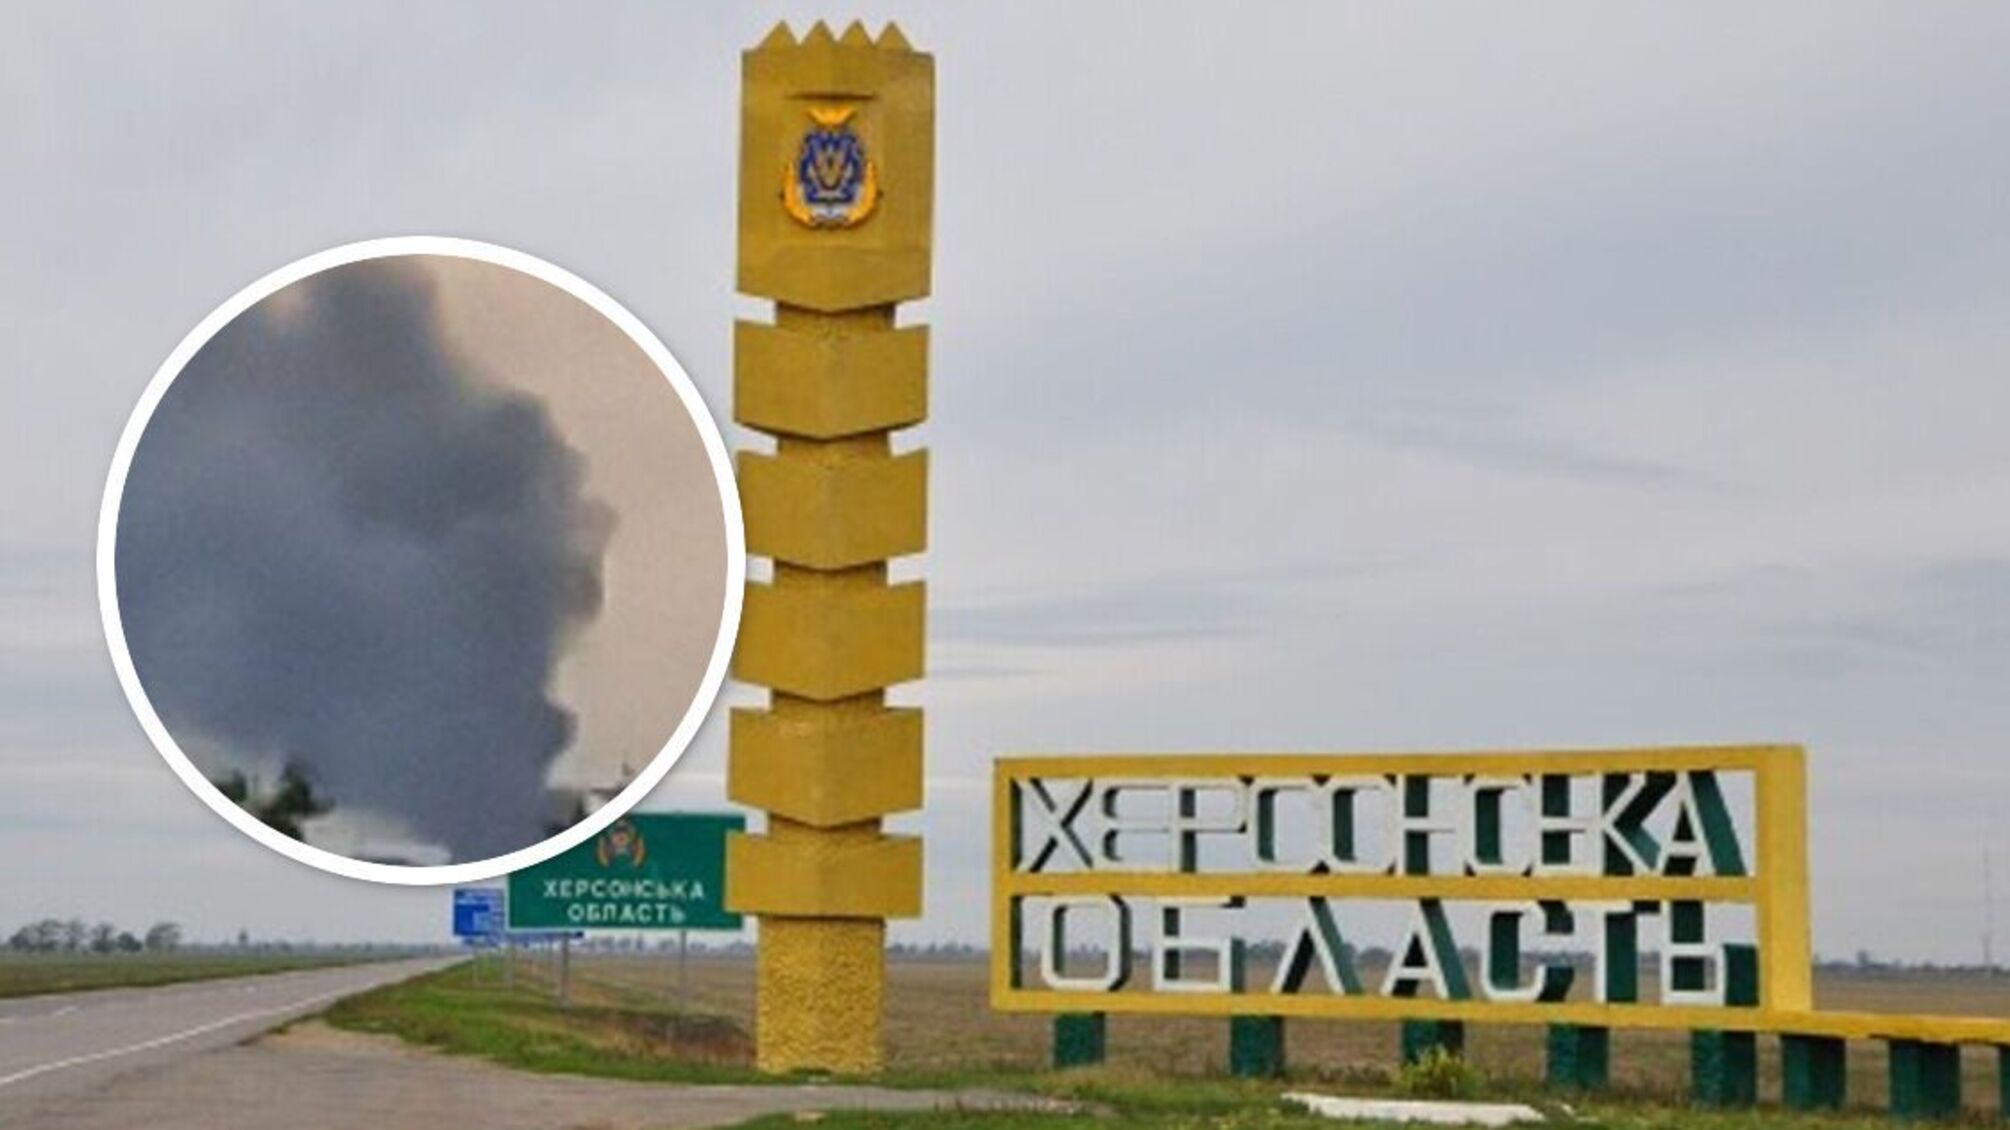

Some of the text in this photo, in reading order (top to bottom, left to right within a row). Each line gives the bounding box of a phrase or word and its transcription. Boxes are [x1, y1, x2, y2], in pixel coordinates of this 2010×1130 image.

[543, 879, 705, 899] ХЕРСОНСЬКА
[566, 903, 686, 923] ОБЛАСТЬ
[1040, 896, 1752, 1006] ОБЛАСТЬ
